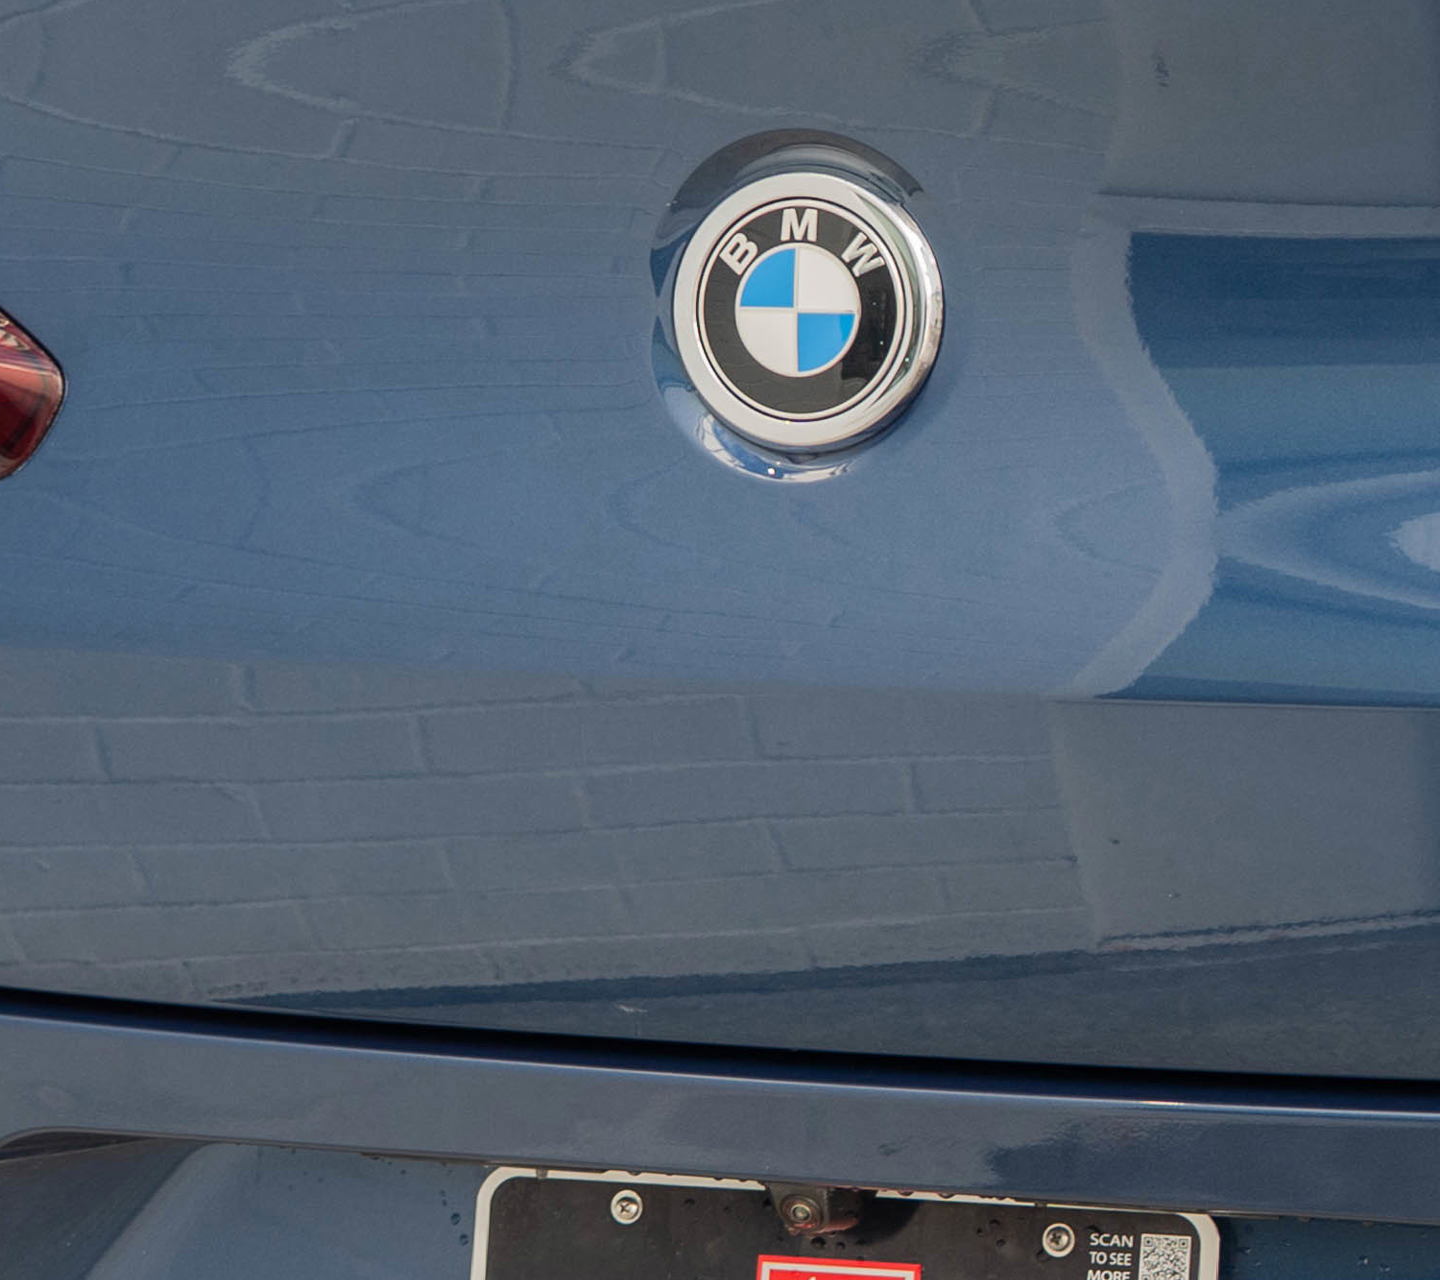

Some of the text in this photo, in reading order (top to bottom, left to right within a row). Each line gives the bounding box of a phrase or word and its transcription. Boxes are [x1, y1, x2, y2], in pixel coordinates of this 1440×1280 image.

[718, 207, 886, 278] BMW
[1089, 1232, 1134, 1248] SCAN
[1088, 1251, 1133, 1267] TO SEE
